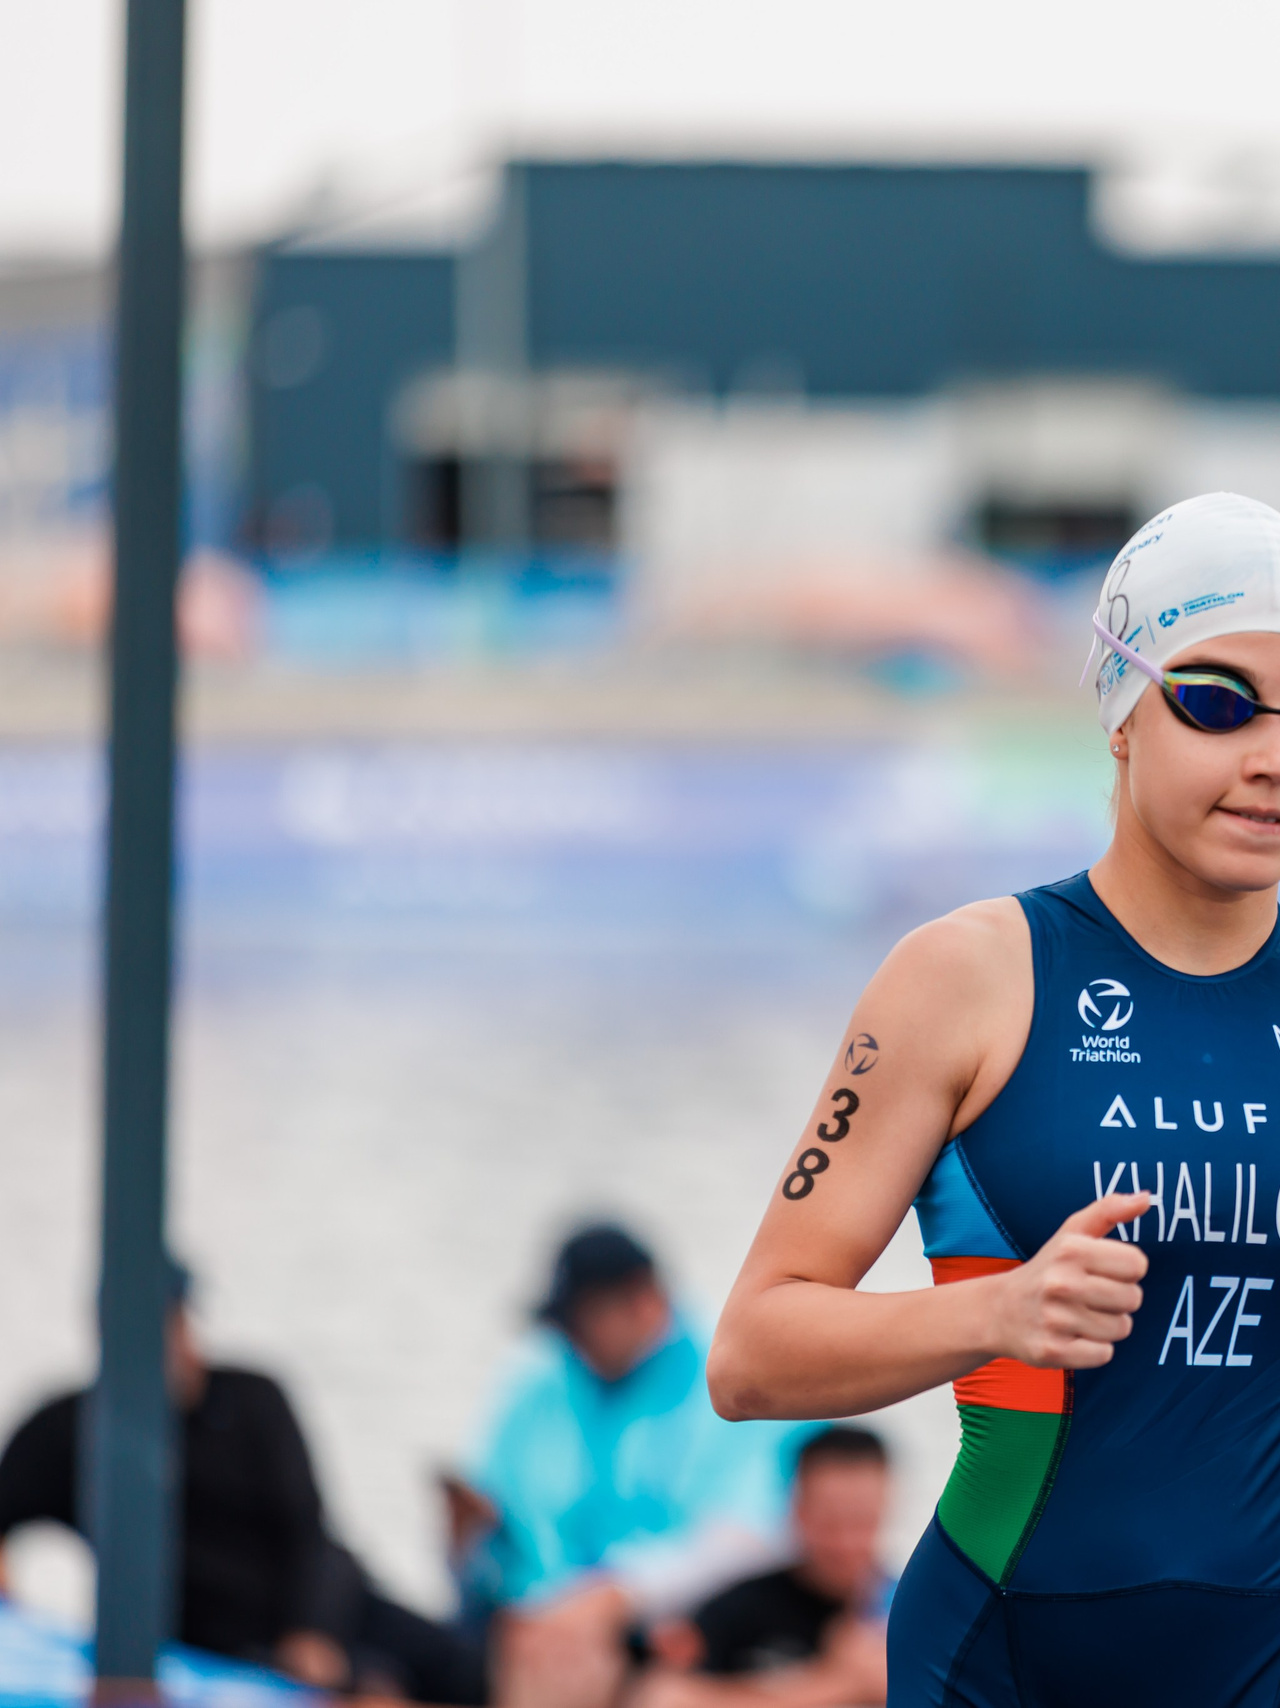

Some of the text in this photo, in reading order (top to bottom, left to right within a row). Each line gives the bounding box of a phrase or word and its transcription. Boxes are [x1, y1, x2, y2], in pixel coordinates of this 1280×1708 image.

[1082, 1034, 1130, 1049] World
[1069, 1047, 1142, 1063] Triathlon
[1157, 1275, 1275, 1367] AZE
